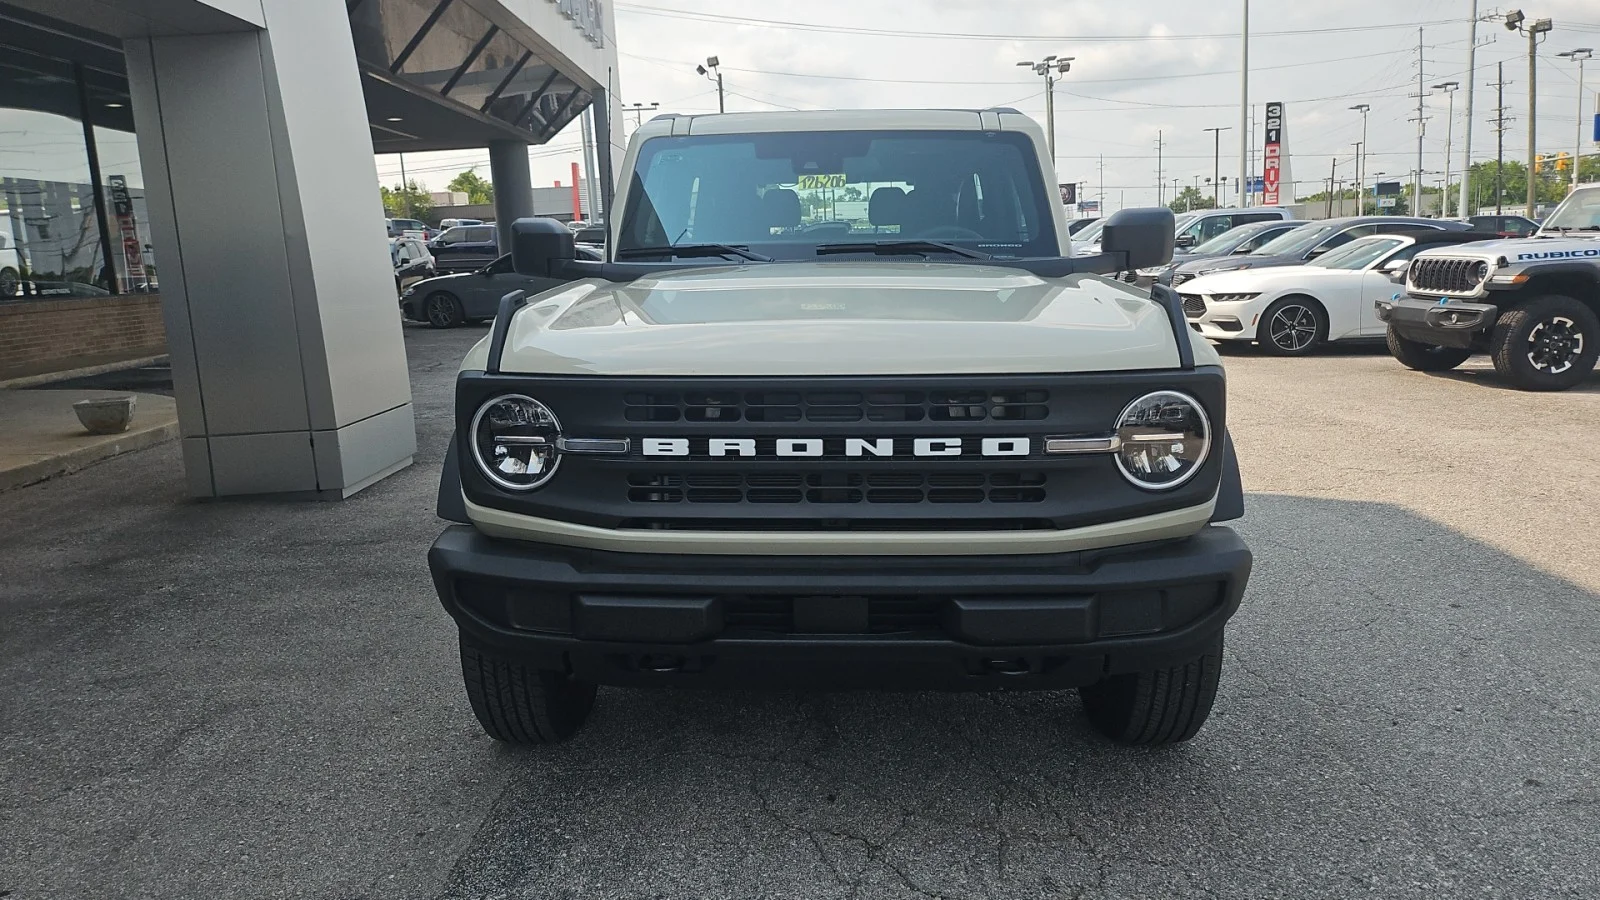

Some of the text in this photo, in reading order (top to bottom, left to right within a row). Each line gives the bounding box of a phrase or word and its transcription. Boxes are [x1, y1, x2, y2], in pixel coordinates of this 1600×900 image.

[1265, 105, 1281, 203] 321 DRIVE
[642, 437, 1030, 456] BRONCO
